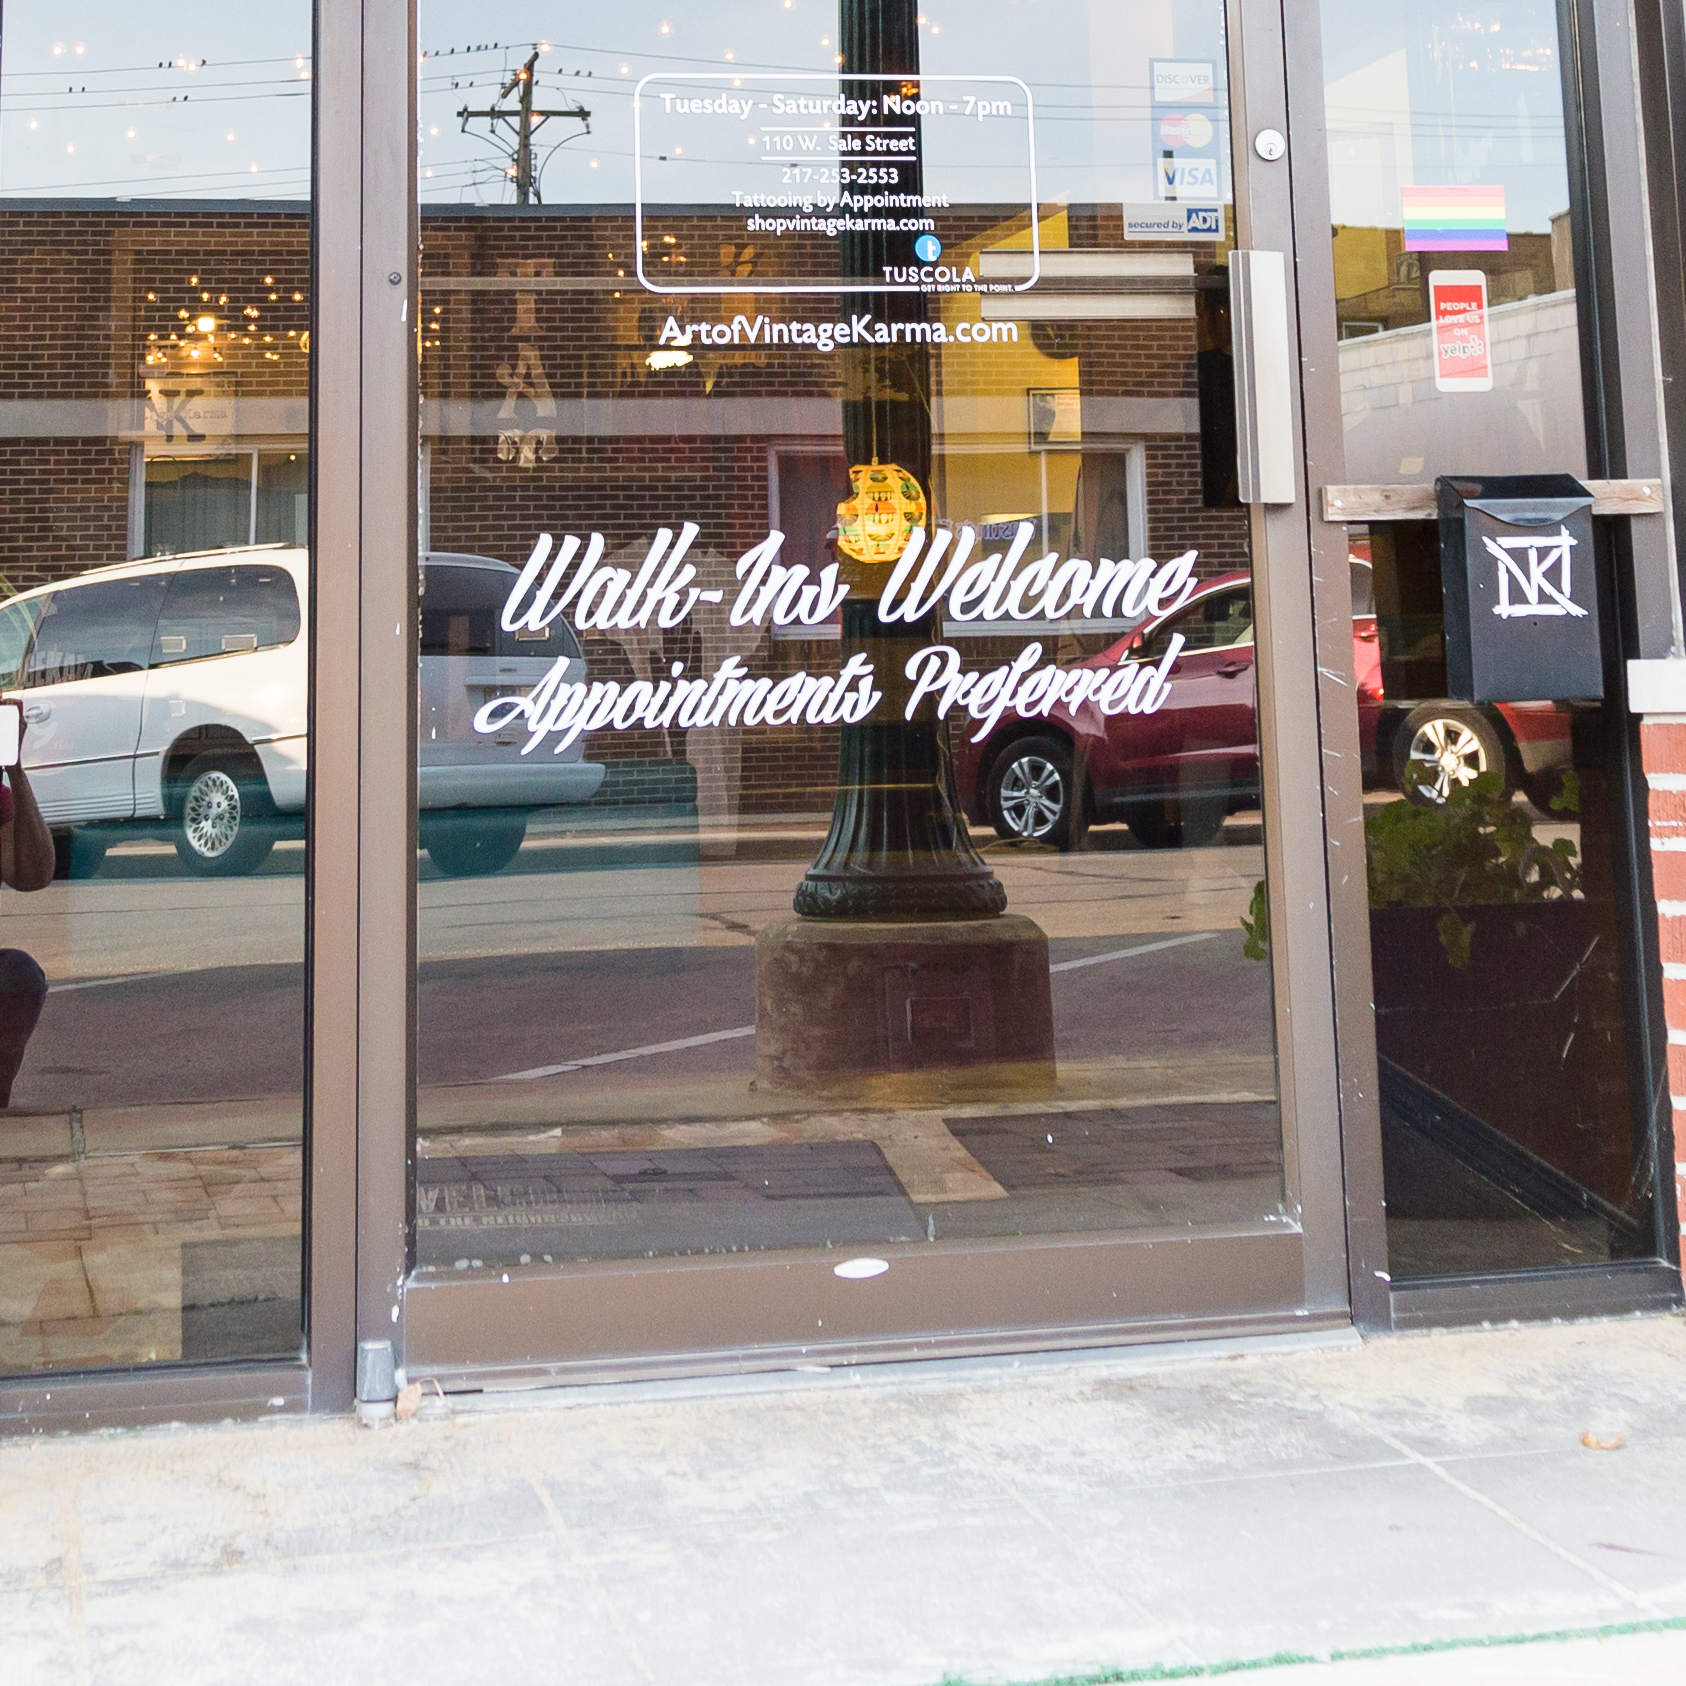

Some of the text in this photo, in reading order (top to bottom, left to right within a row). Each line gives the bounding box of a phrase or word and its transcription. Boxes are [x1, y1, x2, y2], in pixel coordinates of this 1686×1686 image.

[1156, 74, 1210, 85] DISCOVER
[659, 92, 754, 121] Tuesday
[771, 93, 878, 121] Saturday:
[882, 94, 944, 116] Noon
[962, 95, 1012, 122] 7pm
[761, 134, 916, 152] 110 W. Sale Street
[780, 167, 899, 184] 217-253-2553
[1164, 167, 1214, 187] VISA
[730, 190, 950, 212] Tattooing by Appointment
[746, 213, 935, 236] shopvintagekarma.com
[1127, 212, 1219, 231] secured by ADT
[882, 266, 976, 283] TUSCOLA
[920, 284, 936, 293] GET
[961, 284, 974, 293] TO
[1439, 301, 1478, 311] PEOPLE
[1438, 314, 1481, 324] LOVE US
[658, 314, 1019, 352] ArtofVintageKarma.com
[1453, 327, 1469, 336] ON
[1440, 341, 1471, 359] yelp
[500, 521, 1199, 633] Walk-Ins Welcome
[473, 633, 1187, 755] Appointments Preferred
